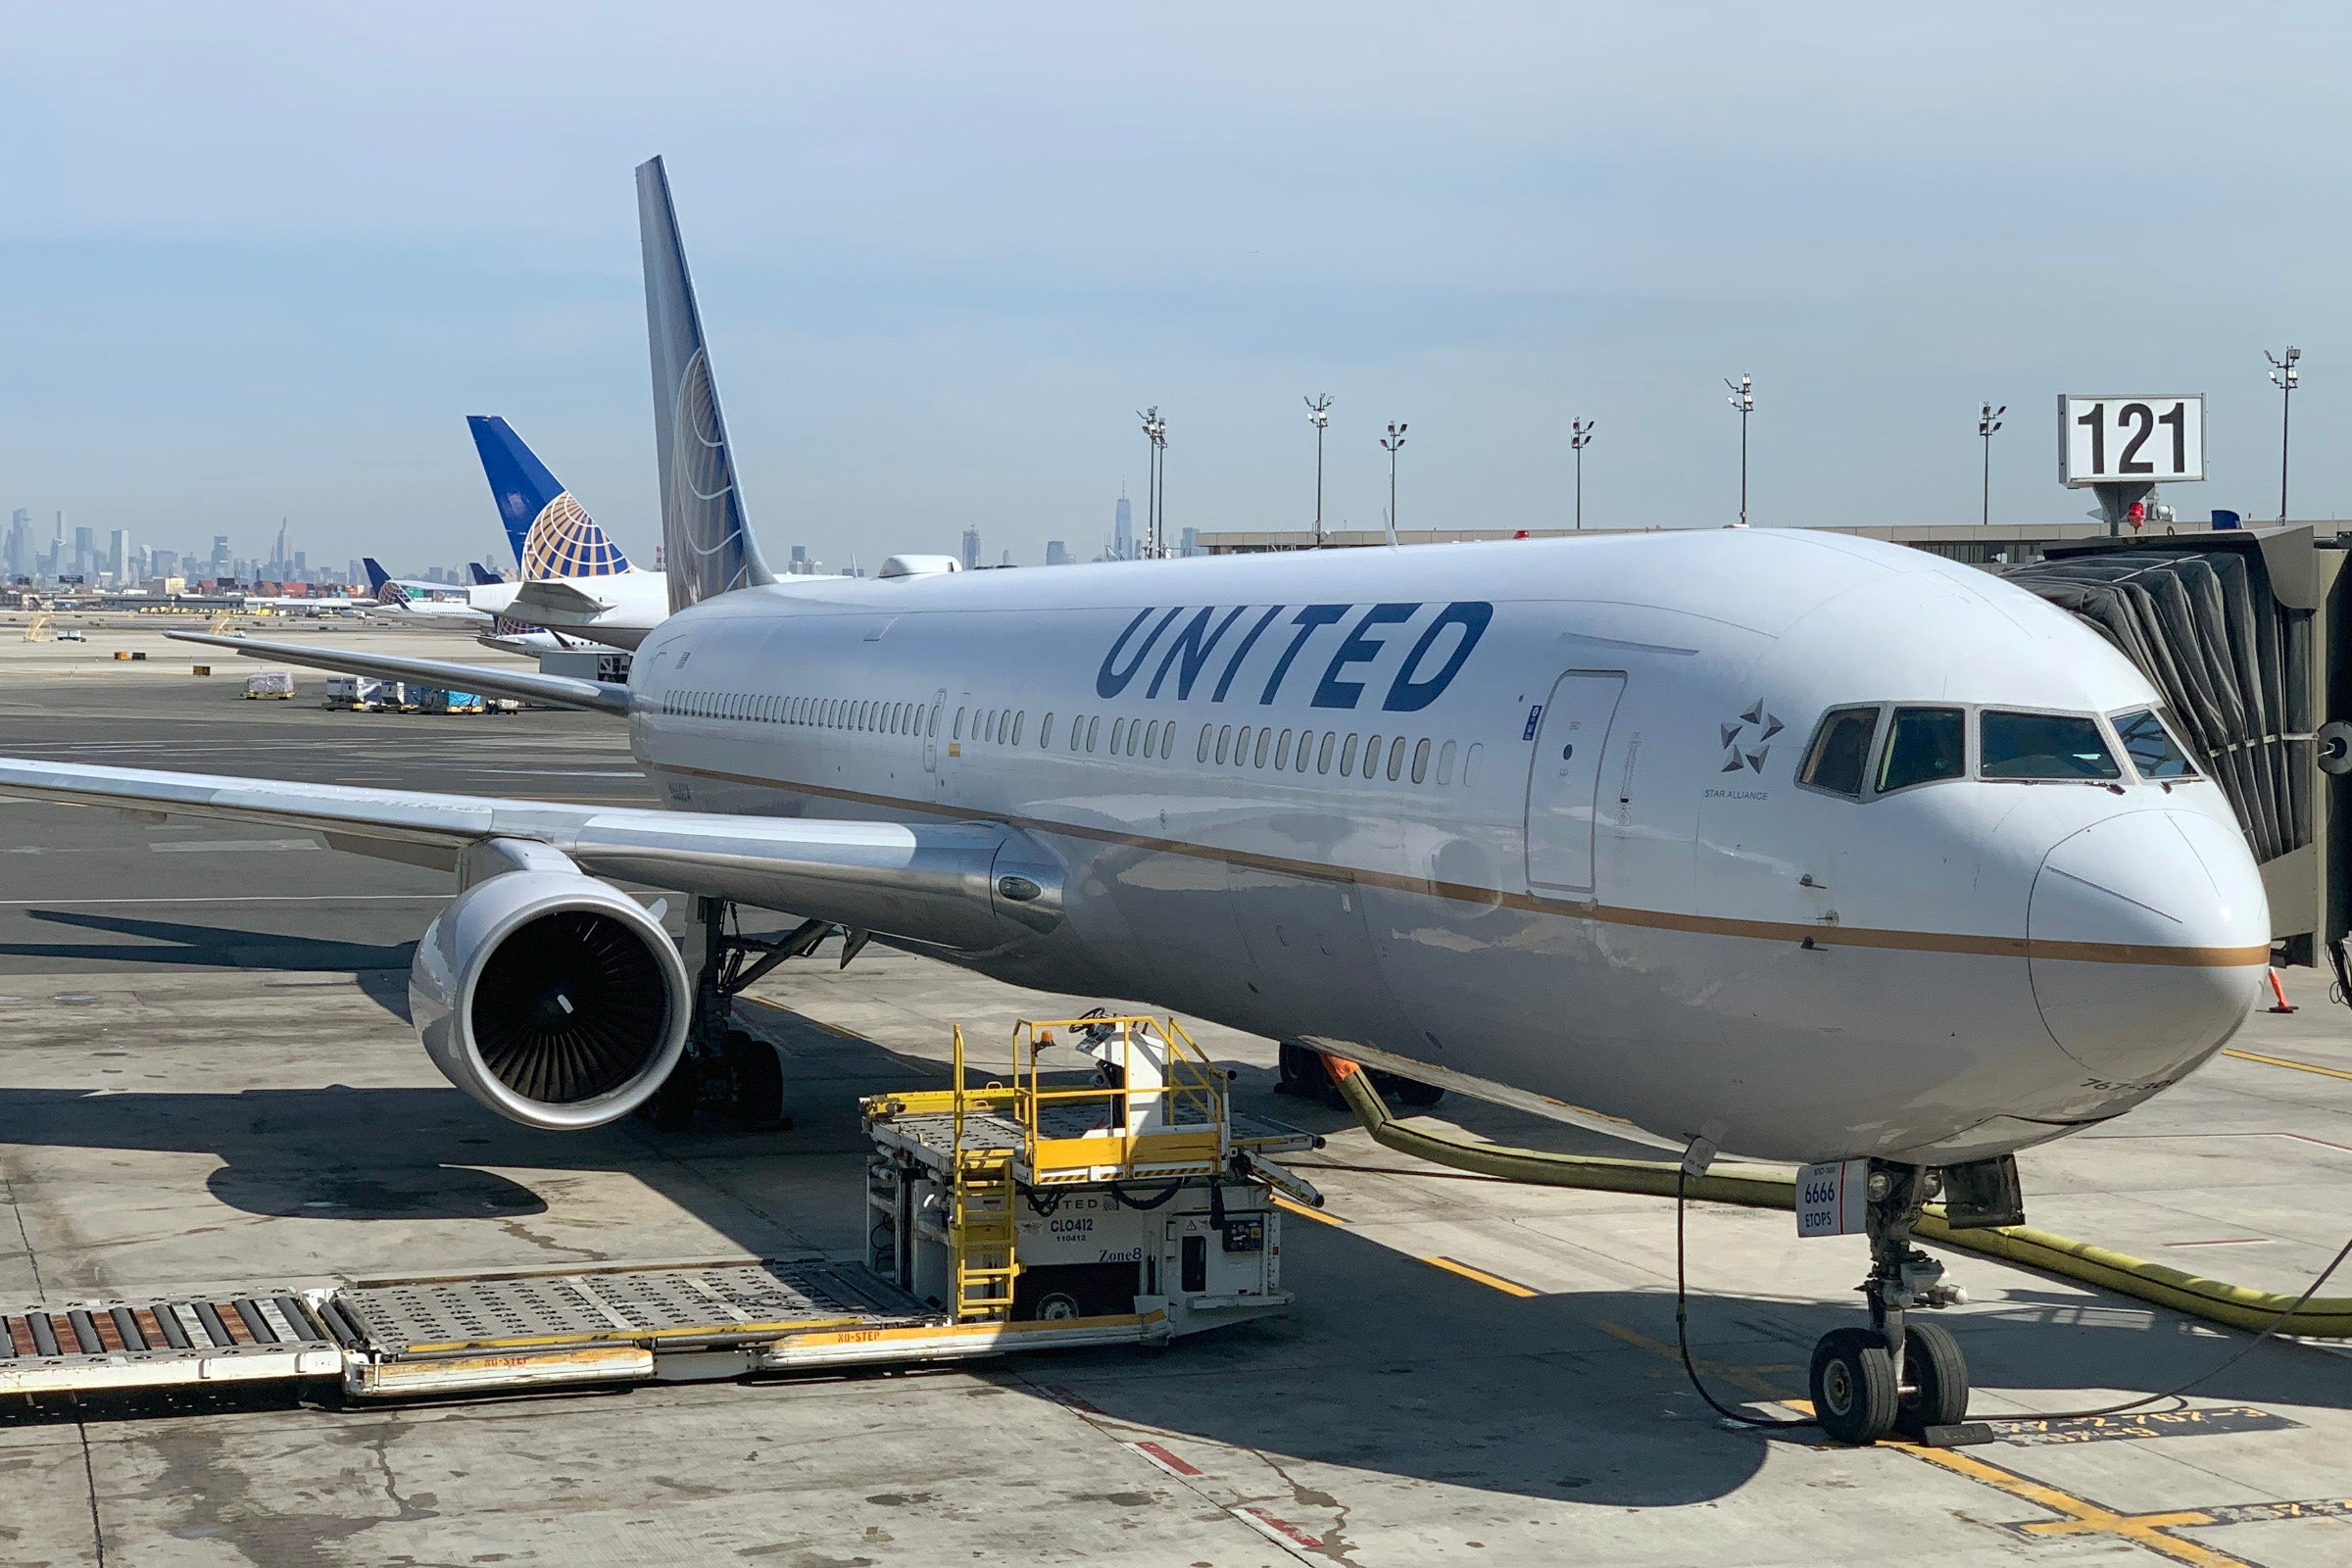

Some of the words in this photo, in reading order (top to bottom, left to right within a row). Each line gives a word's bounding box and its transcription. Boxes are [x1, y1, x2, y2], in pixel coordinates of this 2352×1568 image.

[2078, 402, 2185, 474] 121
[1095, 600, 1494, 712] UNITED
[1704, 788, 1726, 799] STAR
[1726, 790, 1769, 801] ALLIANCE
[1804, 1181, 1836, 1204] 6666
[1804, 1210, 1833, 1228] ETOPS
[1055, 1234, 1087, 1243] 110412
[837, 1331, 880, 1344] NO-STEP
